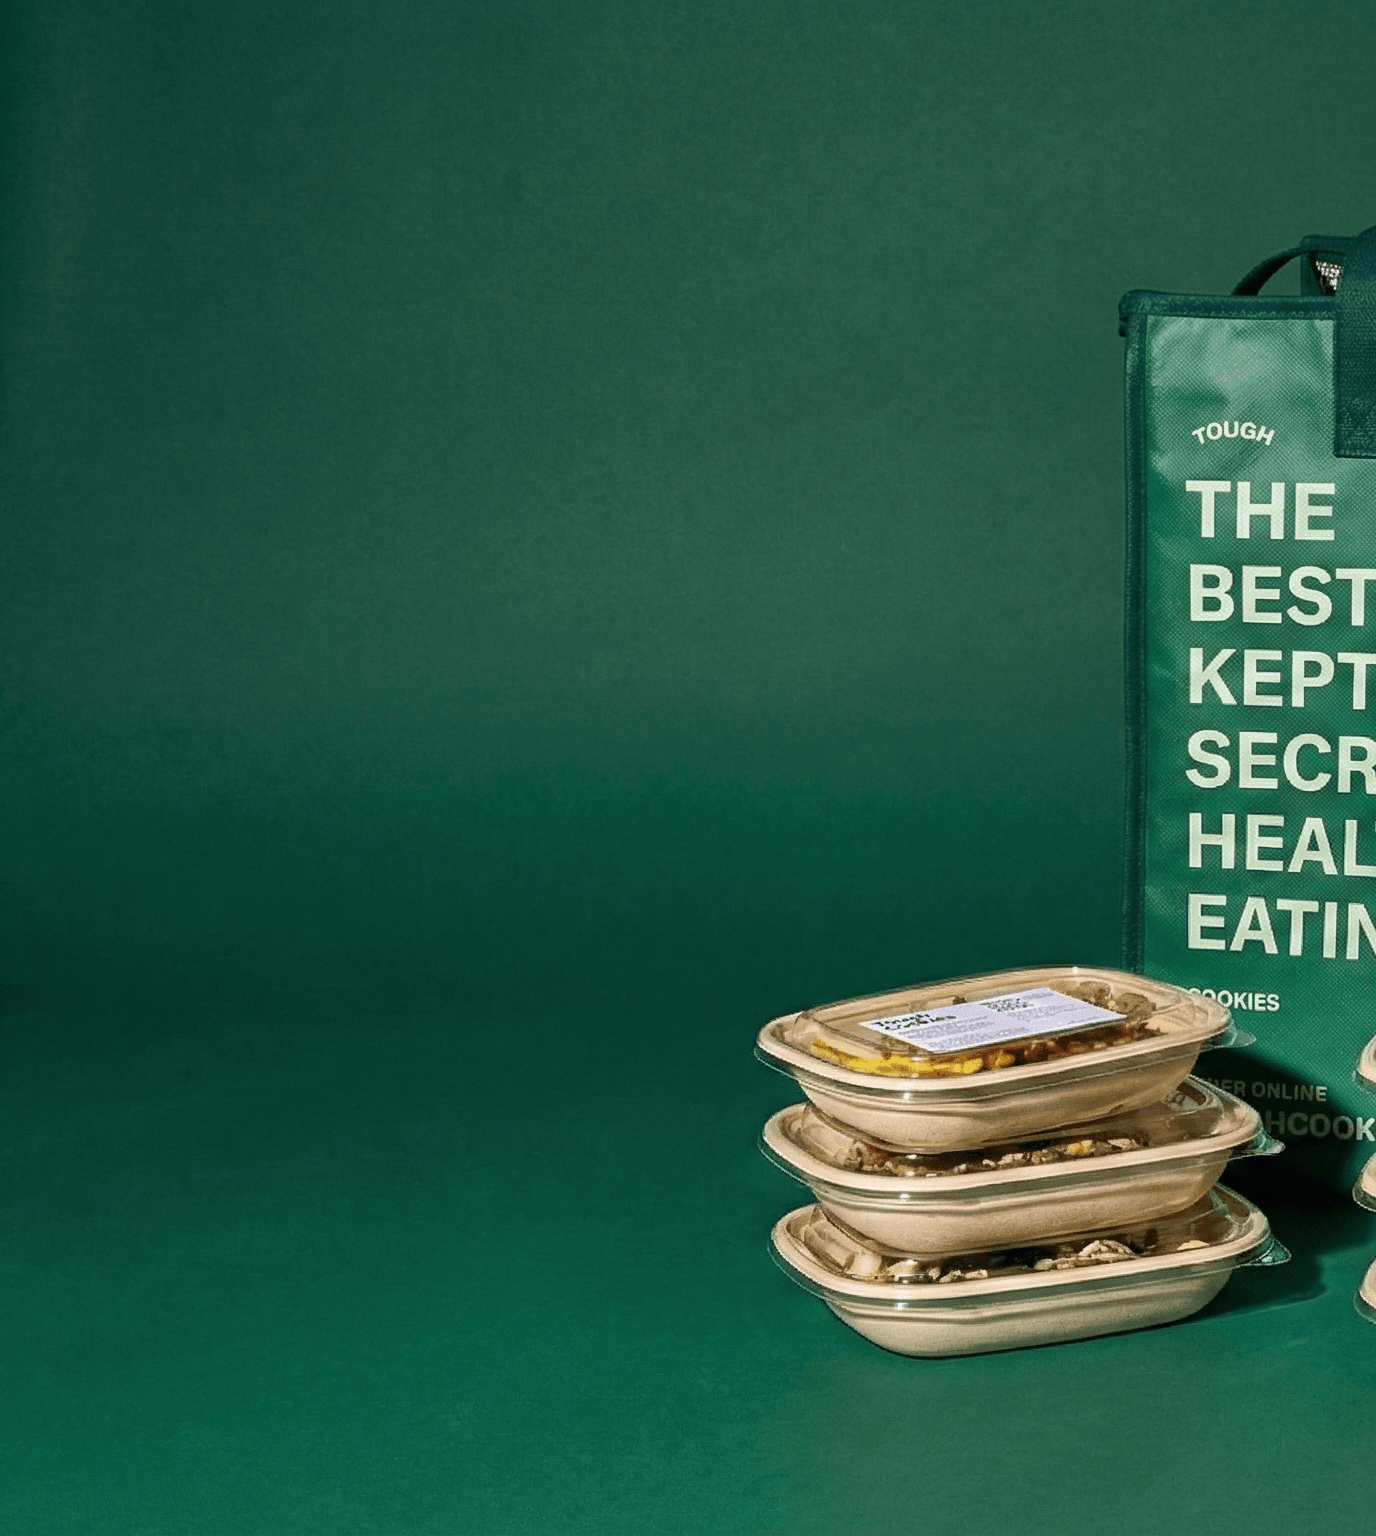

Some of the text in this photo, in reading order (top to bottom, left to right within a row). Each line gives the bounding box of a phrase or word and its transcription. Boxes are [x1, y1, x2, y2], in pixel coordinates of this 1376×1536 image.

[1191, 420, 1275, 446] TOUGH
[1185, 479, 1336, 541] THE
[1251, 1080, 1329, 1102] ONLINE
